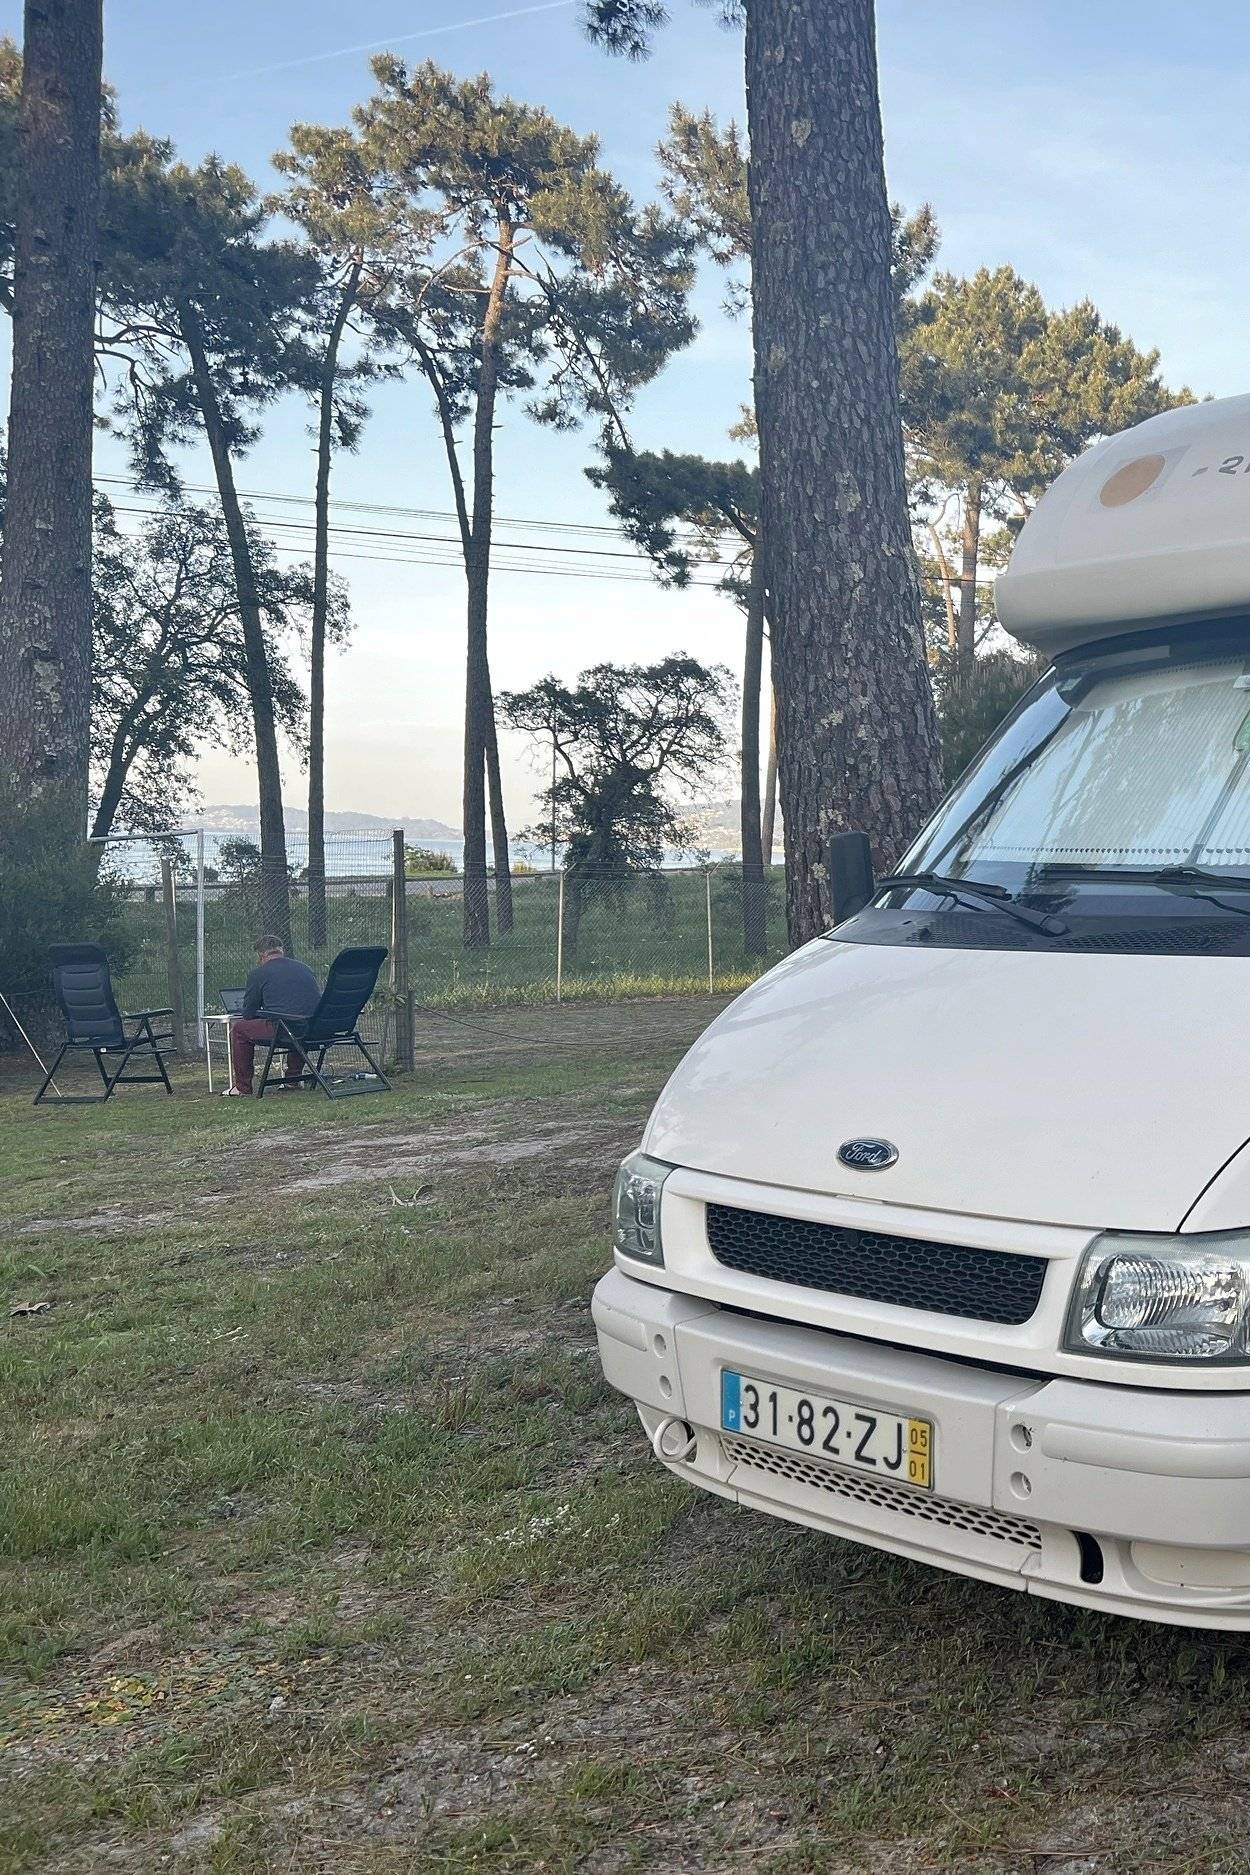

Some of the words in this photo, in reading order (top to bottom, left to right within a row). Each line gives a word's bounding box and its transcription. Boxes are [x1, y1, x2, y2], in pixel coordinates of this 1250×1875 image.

[843, 1141, 884, 1164] Ford
[728, 1409, 736, 1423] P
[910, 1427, 928, 1448] 05
[909, 1460, 926, 1481] 01
